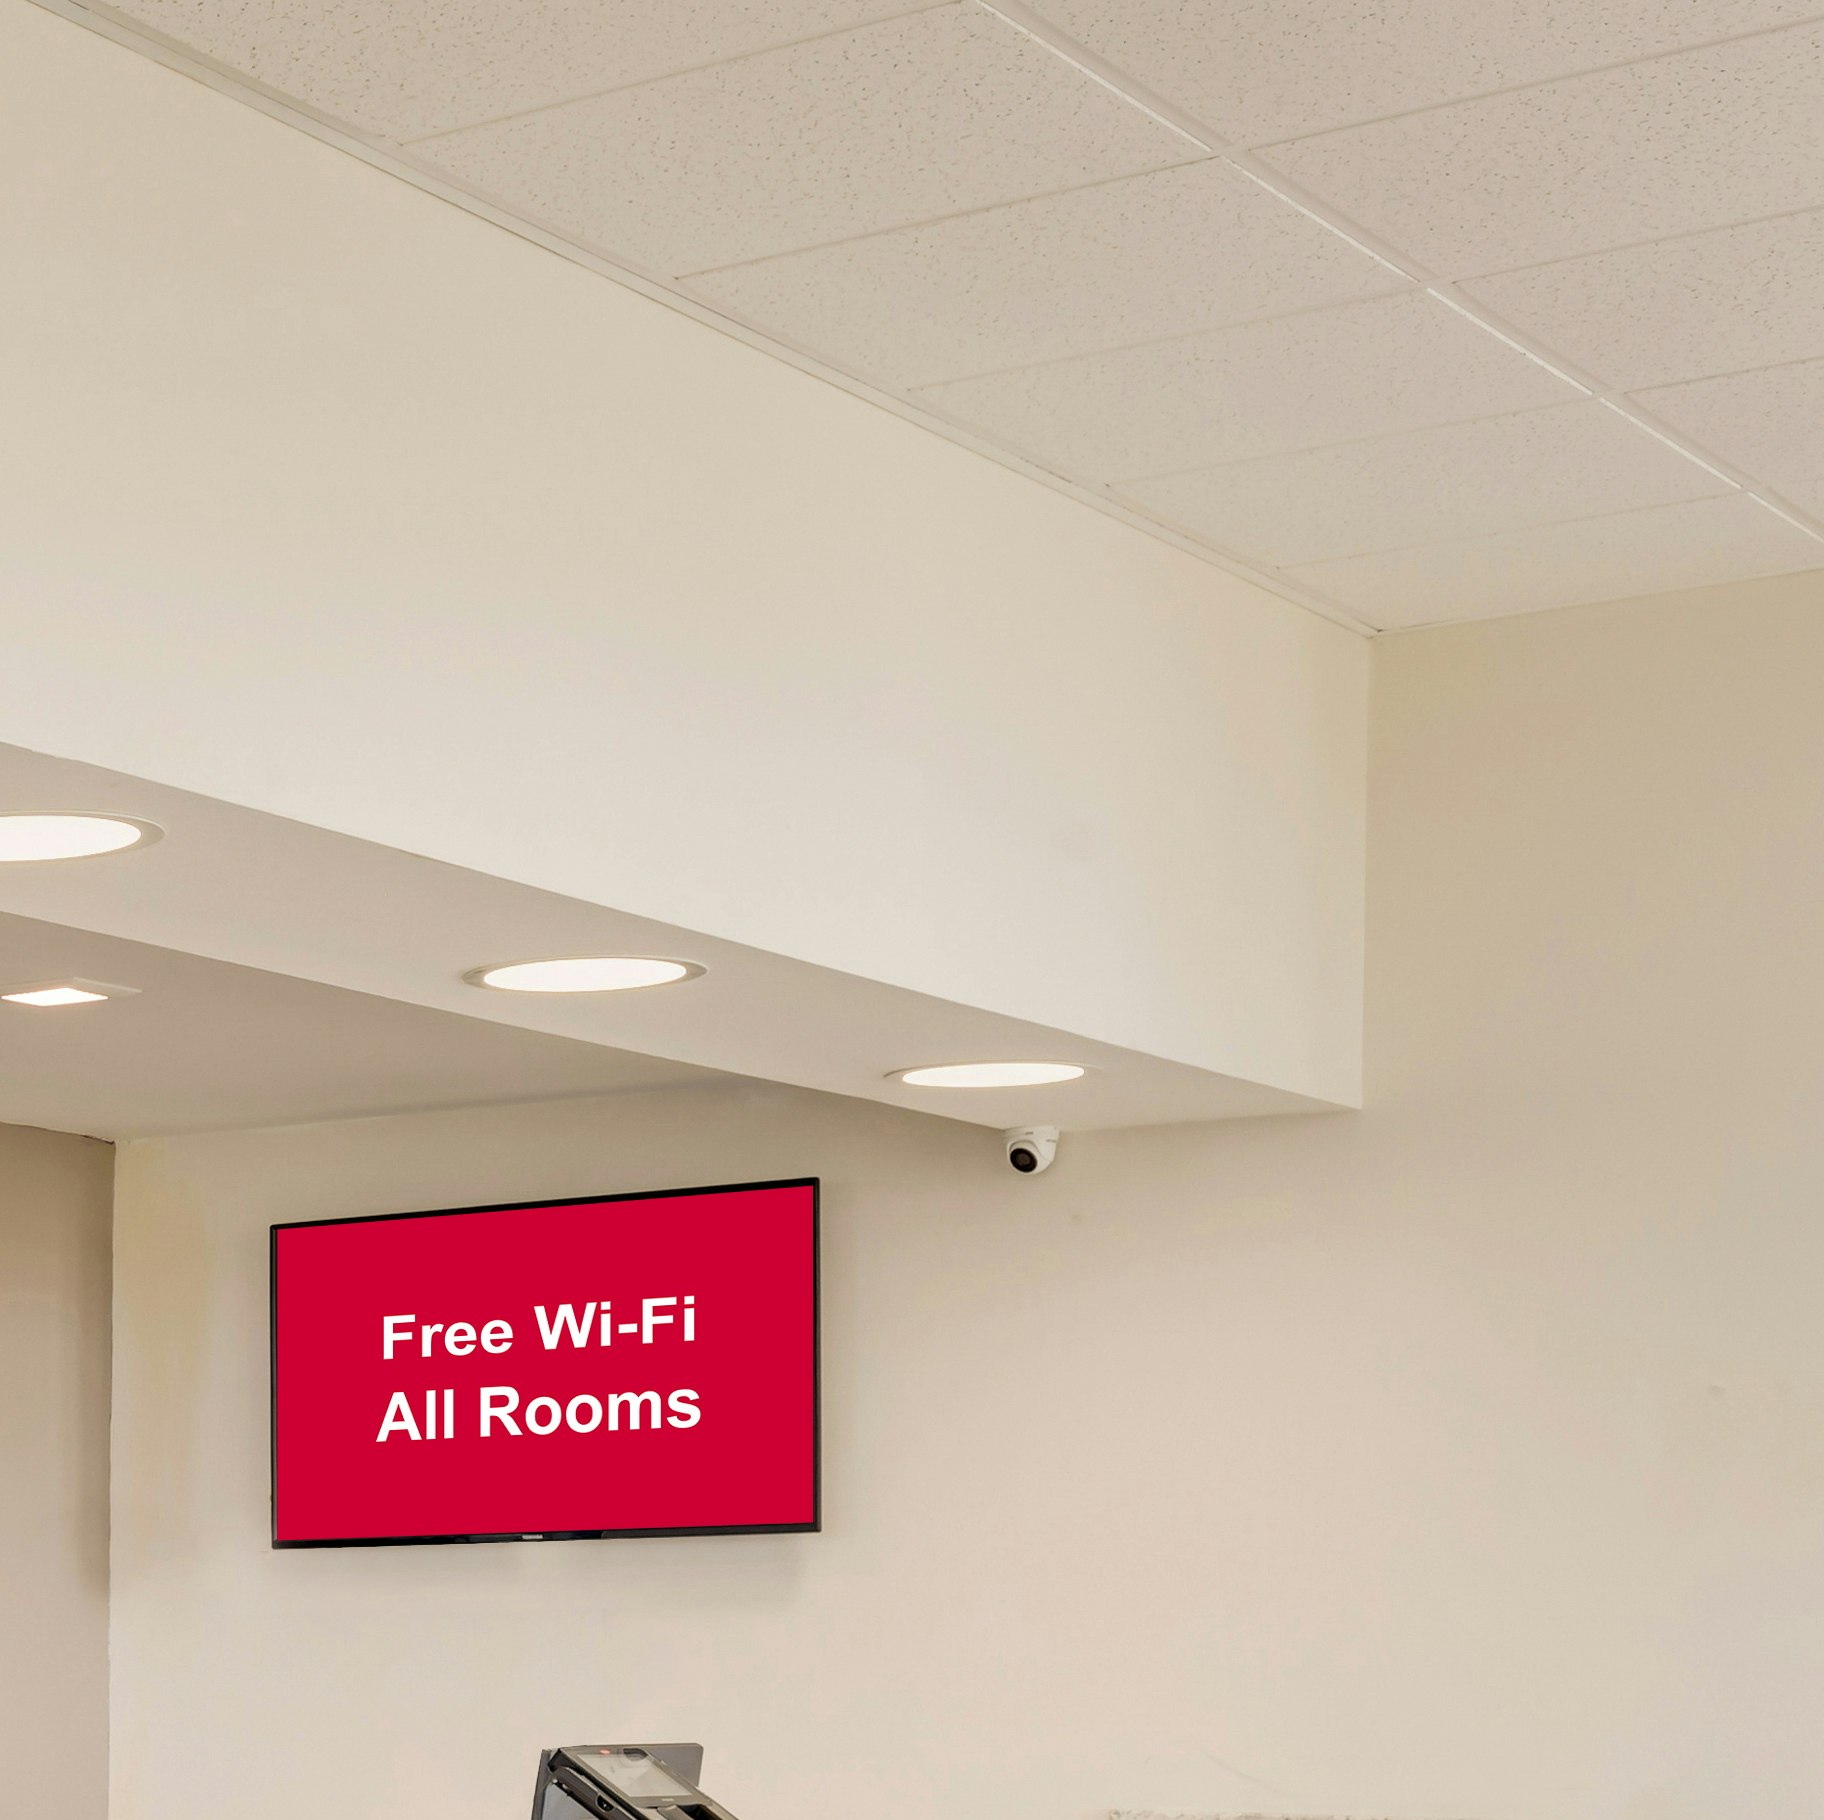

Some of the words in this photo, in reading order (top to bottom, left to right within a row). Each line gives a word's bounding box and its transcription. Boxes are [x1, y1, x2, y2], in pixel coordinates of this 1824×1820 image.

[383, 1314, 514, 1360] Free
[533, 1295, 695, 1350] Wi-Fi
[375, 1388, 454, 1443] All
[479, 1385, 701, 1438] Rooms
